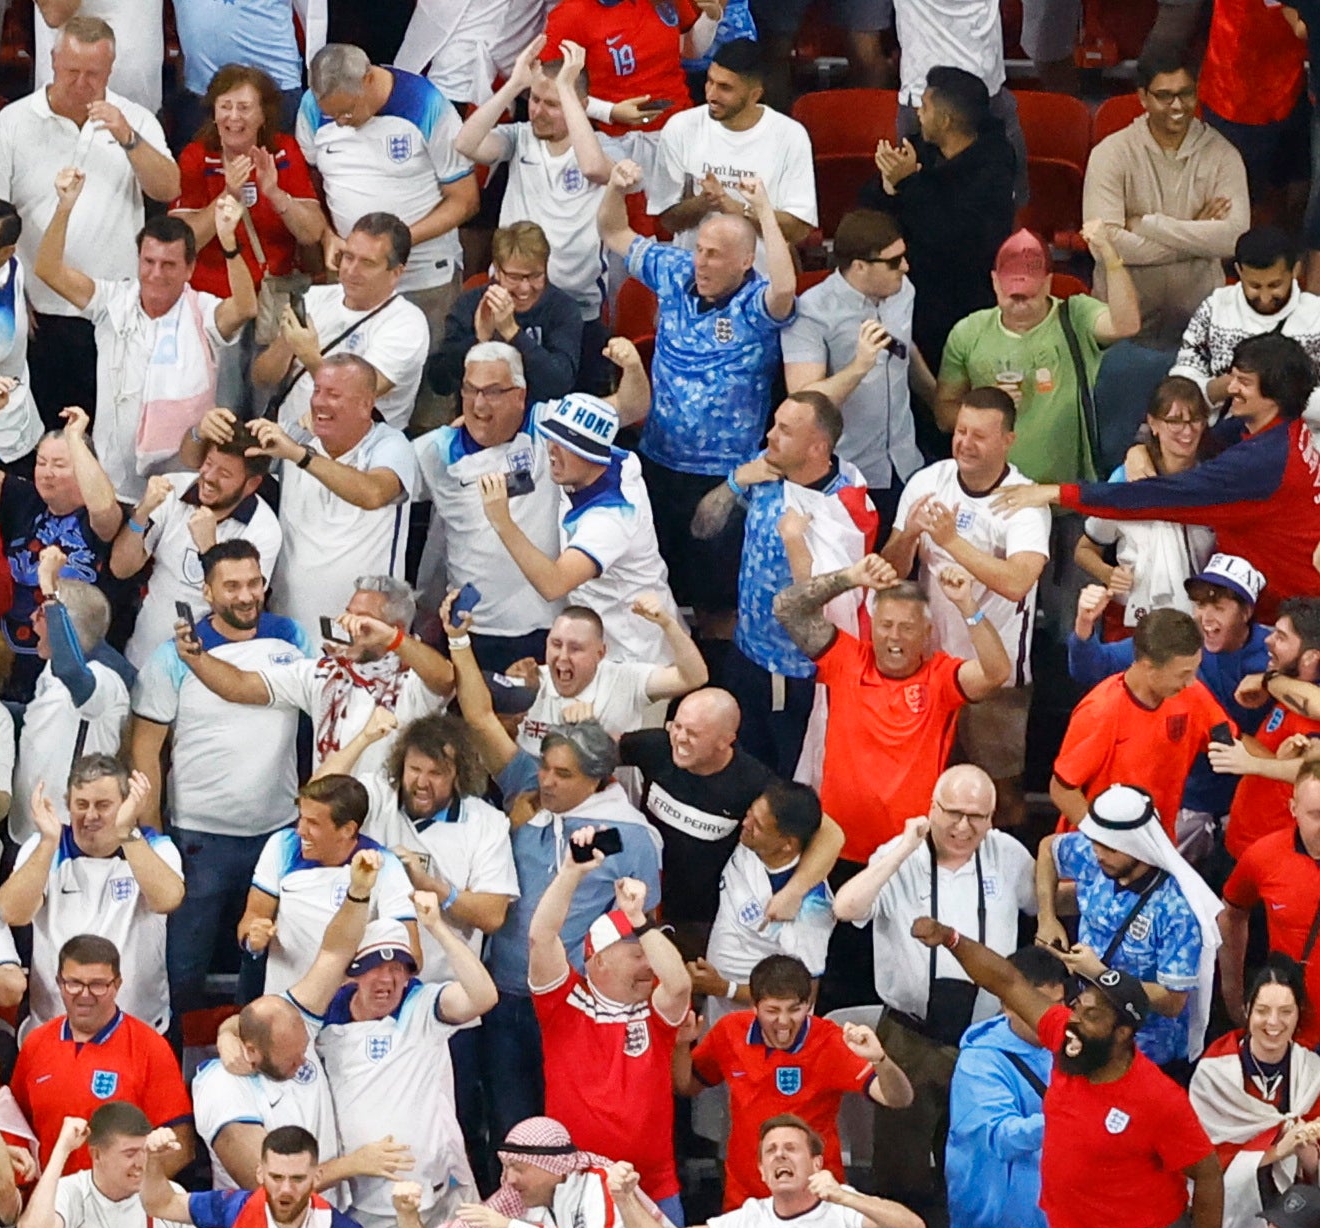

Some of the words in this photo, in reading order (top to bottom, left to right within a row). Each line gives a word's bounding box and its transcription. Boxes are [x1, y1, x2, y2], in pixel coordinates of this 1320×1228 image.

[609, 44, 637, 76] 19
[573, 408, 614, 438] HOME
[654, 796, 682, 819] FRED
[683, 814, 727, 835] PERRY
